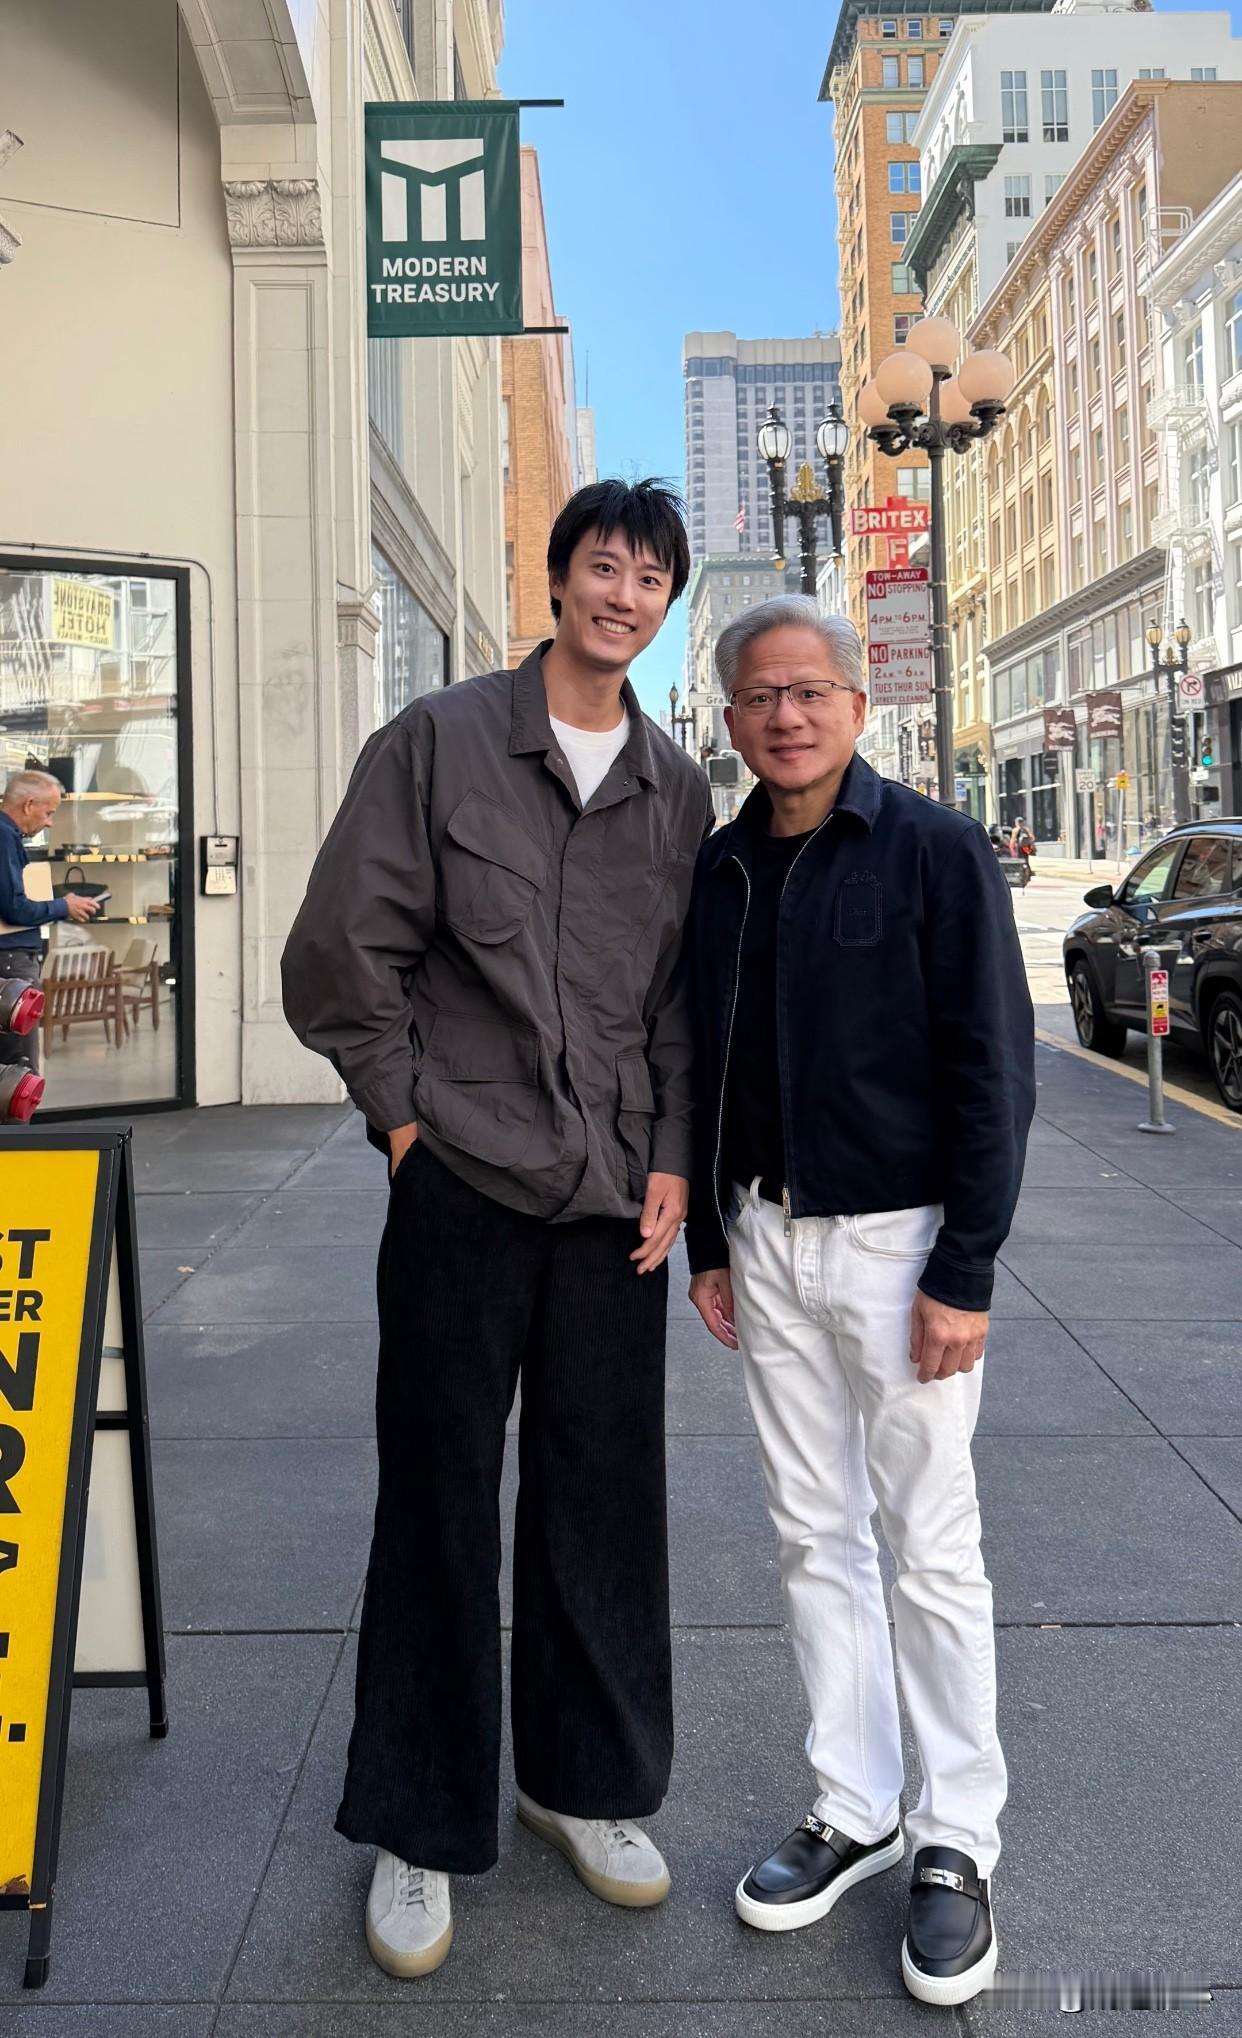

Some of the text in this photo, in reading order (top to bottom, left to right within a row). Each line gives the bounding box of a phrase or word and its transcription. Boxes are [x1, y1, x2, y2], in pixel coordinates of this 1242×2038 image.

[382, 256, 487, 277] MODERN
[371, 282, 500, 303] TREASURY
[853, 510, 926, 533] BRITEX
[889, 538, 907, 569] F
[872, 570, 921, 581] TOW-AWAY
[868, 582, 926, 597] NO STOPPING
[871, 646, 930, 662] NO PARKING
[875, 681, 930, 693] TUES THUR SUN
[1079, 781, 1094, 790] 20
[0, 1229, 51, 1279] T
